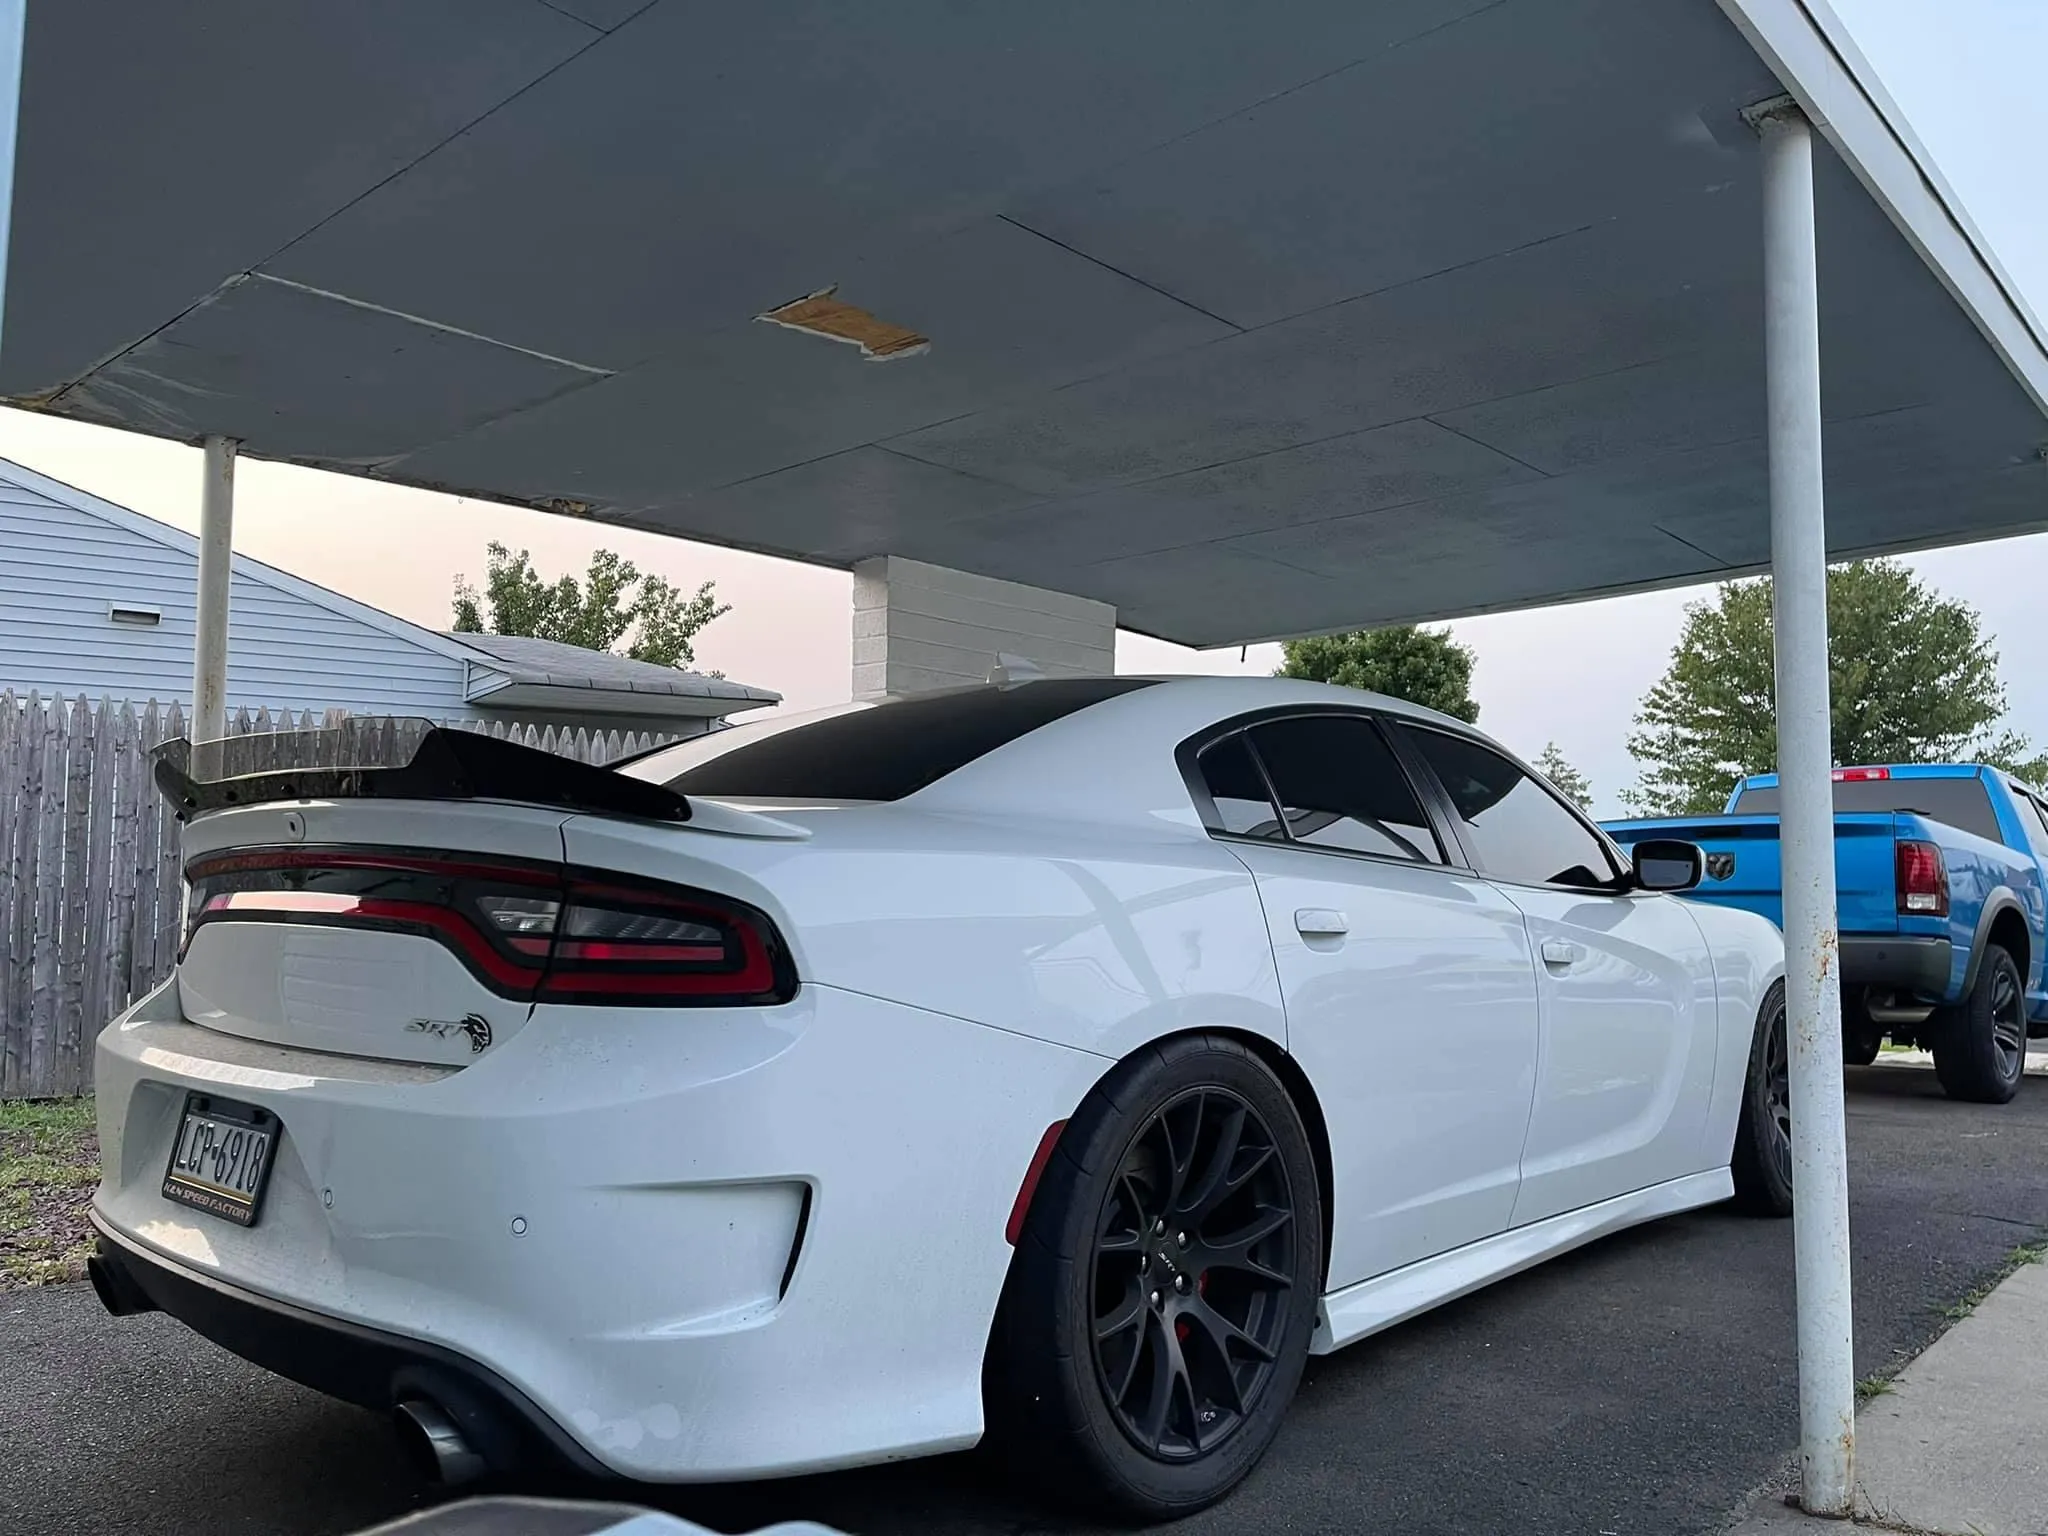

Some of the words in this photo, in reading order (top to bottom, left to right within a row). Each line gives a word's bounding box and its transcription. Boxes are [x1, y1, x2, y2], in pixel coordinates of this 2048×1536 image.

[176, 1117, 266, 1193] LCP-6918
[182, 1189, 210, 1206] SPEED
[209, 1197, 253, 1220] FACTORY
